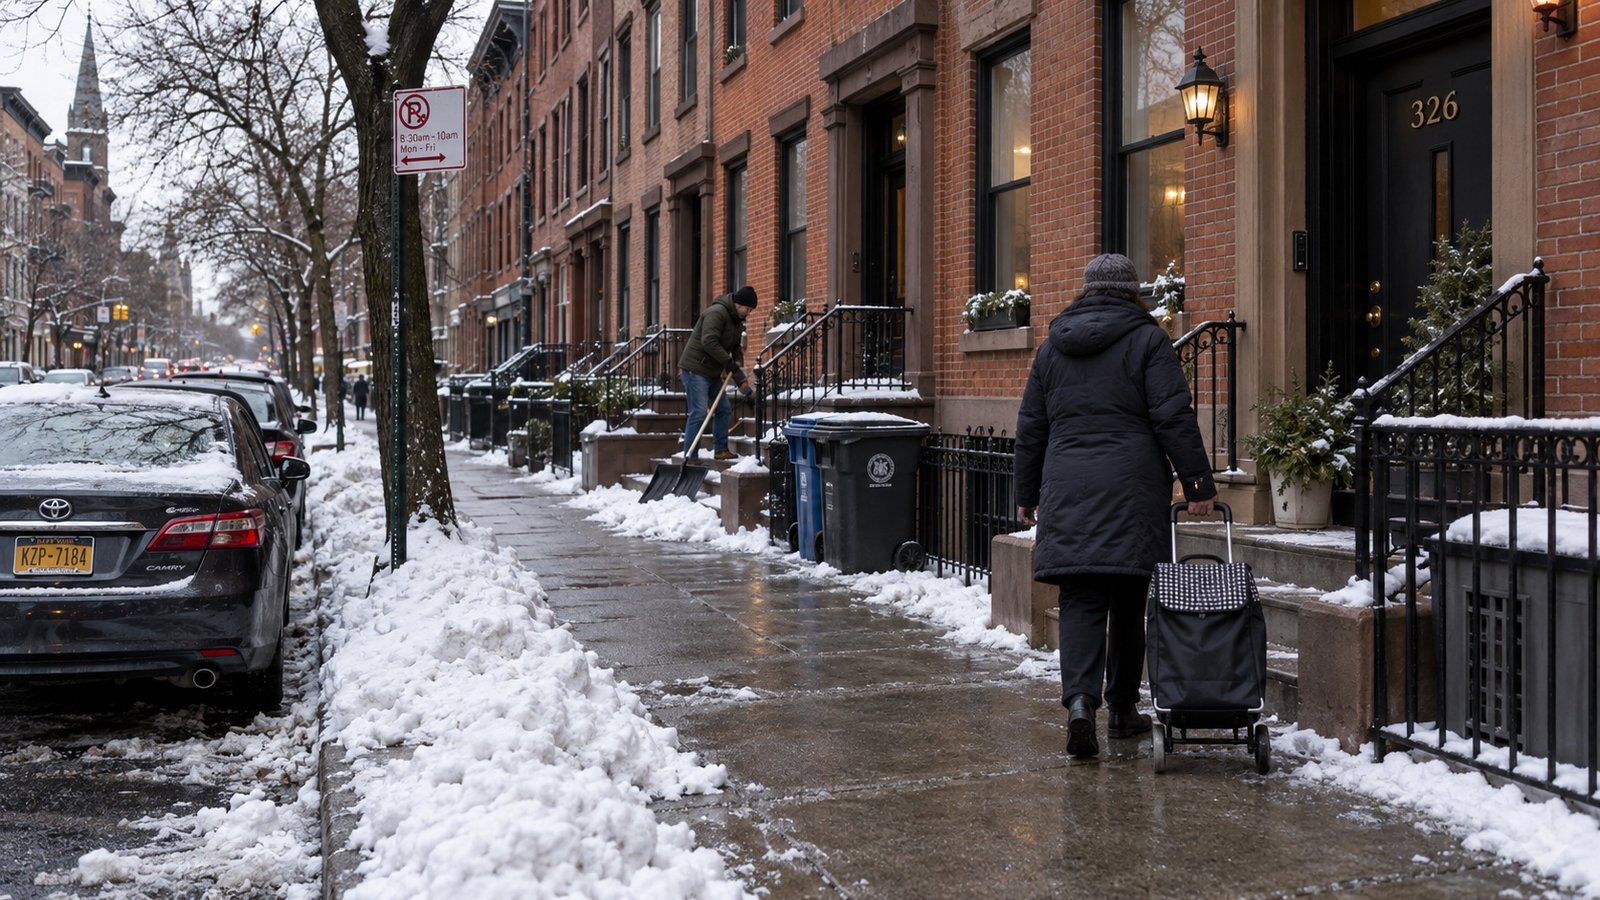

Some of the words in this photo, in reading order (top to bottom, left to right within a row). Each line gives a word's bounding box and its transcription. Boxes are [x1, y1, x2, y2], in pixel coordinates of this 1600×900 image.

[1411, 90, 1459, 129] 326
[400, 133, 430, 143] 8:30am
[437, 131, 458, 140] 10am
[400, 145, 417, 153] Mon
[425, 143, 436, 152] Fri
[21, 547, 87, 566] KZP-7184
